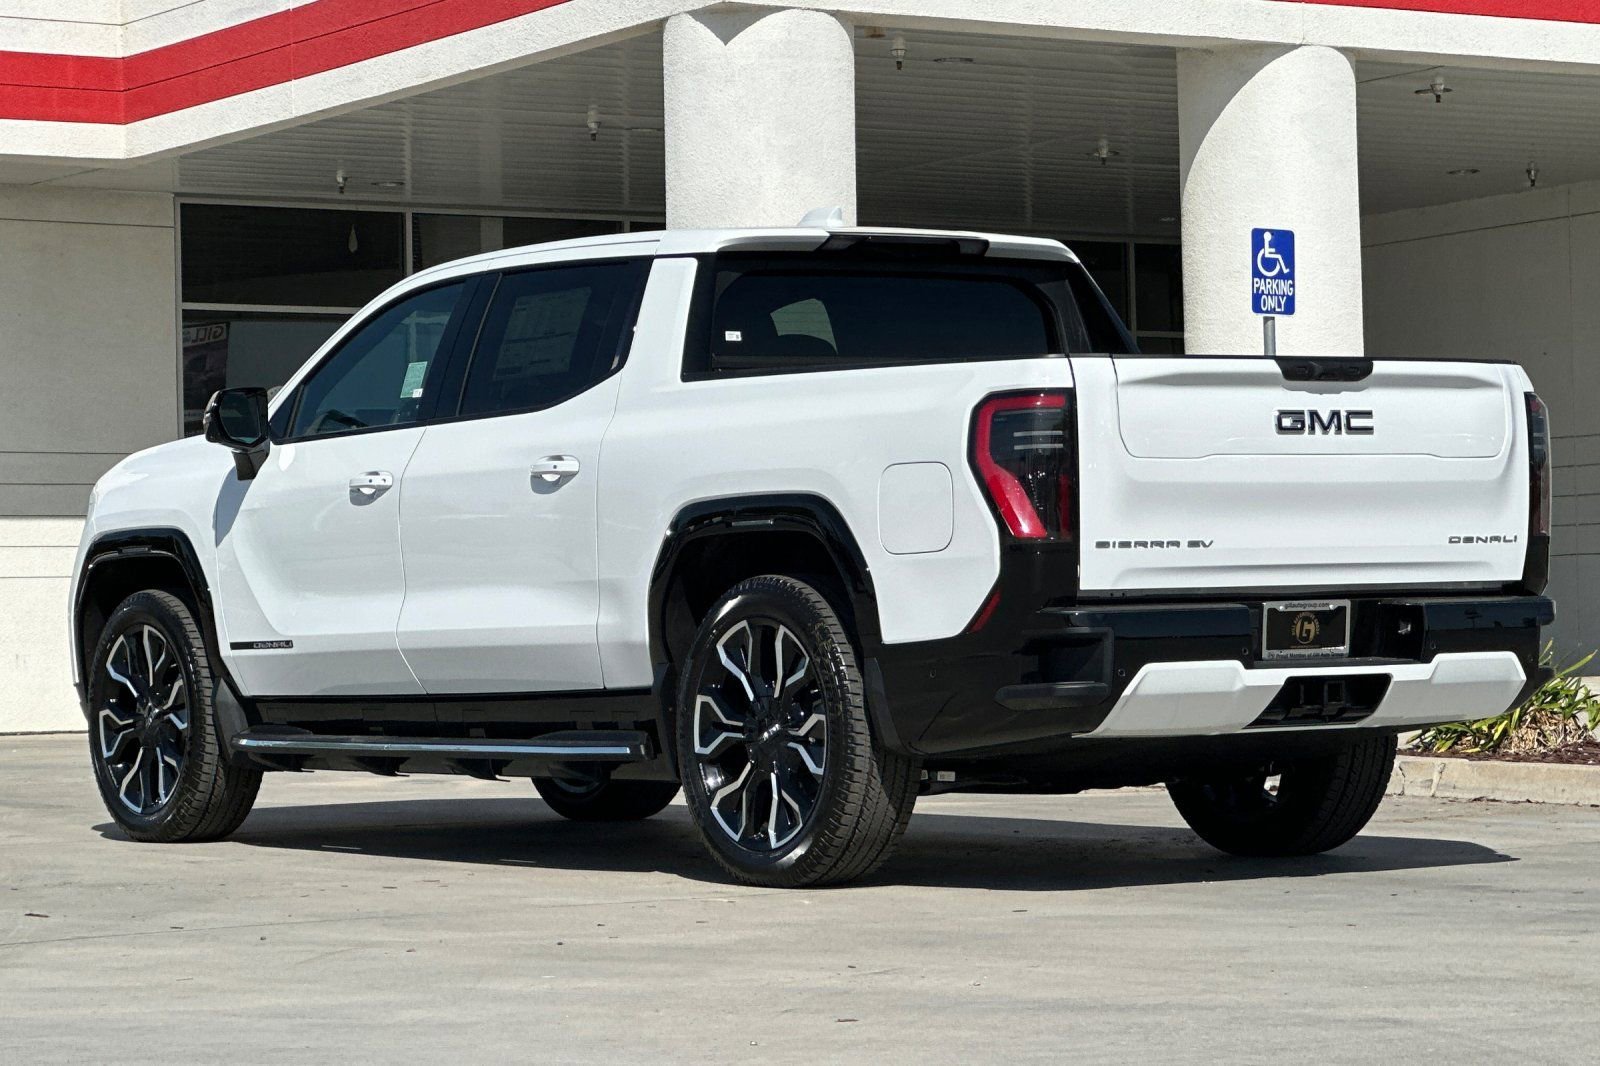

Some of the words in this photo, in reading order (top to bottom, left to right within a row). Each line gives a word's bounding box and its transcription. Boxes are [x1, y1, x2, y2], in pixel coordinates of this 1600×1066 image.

[1253, 278, 1293, 296] PARKING
[1261, 295, 1287, 312] ONLY
[1276, 409, 1374, 435] GMC
[1095, 540, 1181, 549] SIERRA
[1187, 540, 1214, 548] EV
[1448, 535, 1518, 544] DENALI
